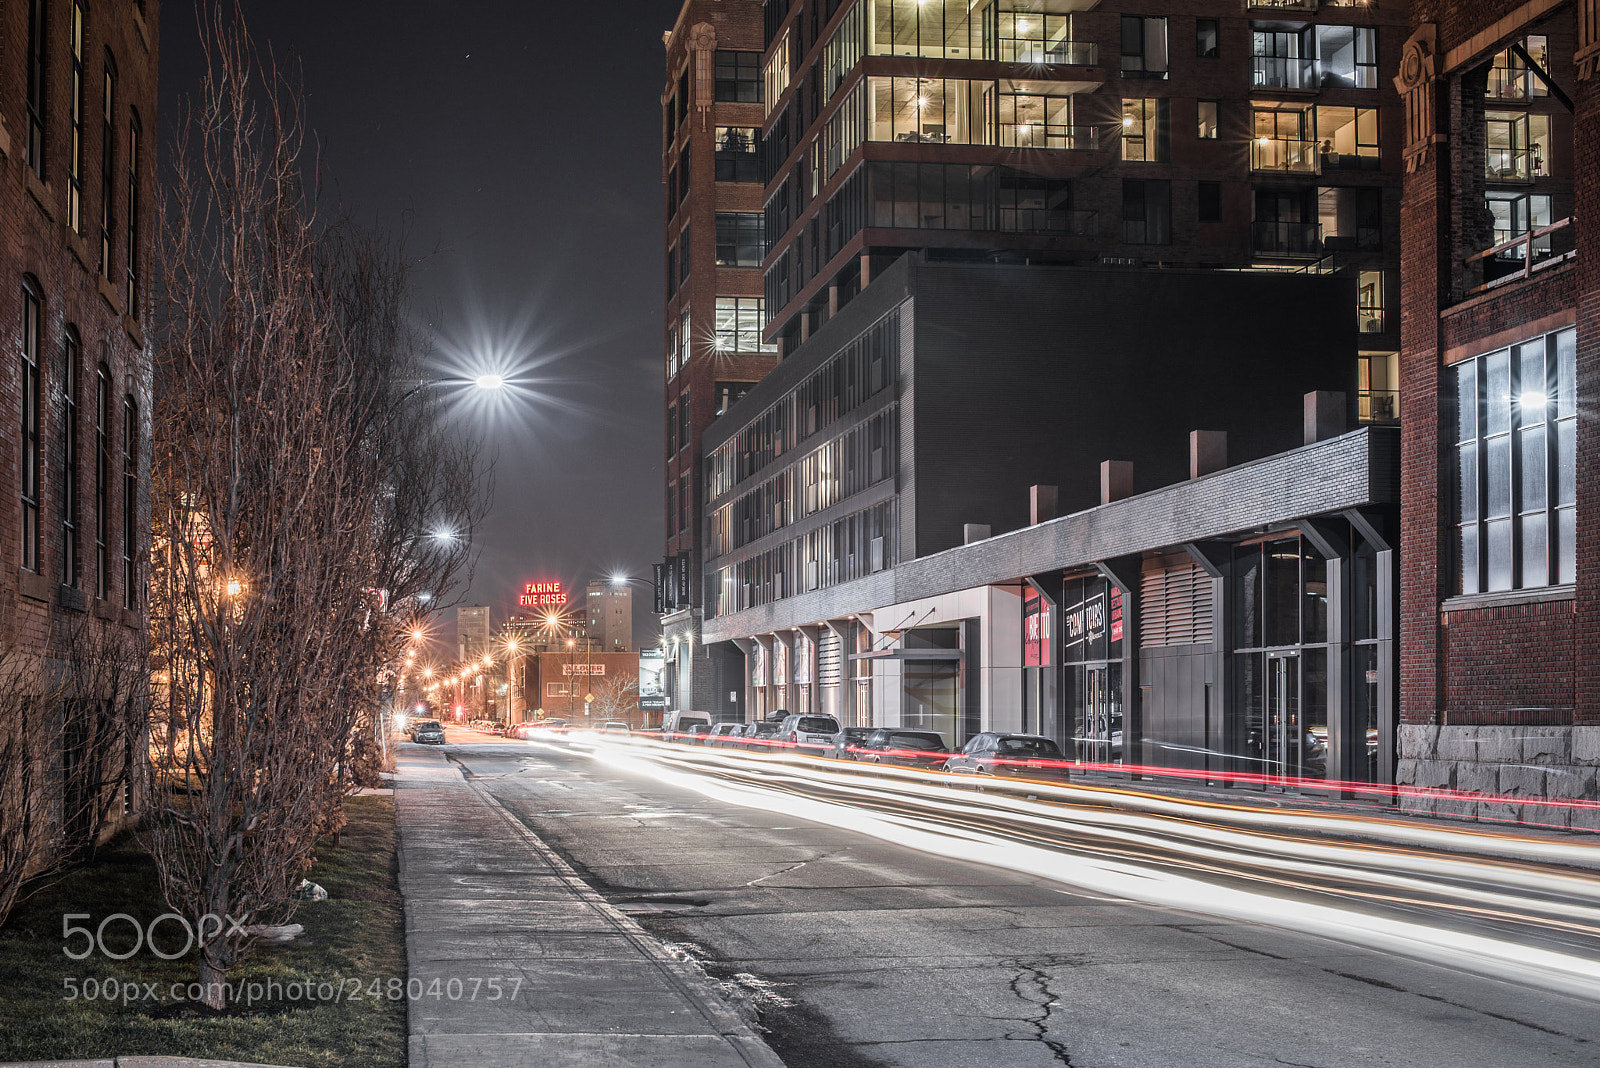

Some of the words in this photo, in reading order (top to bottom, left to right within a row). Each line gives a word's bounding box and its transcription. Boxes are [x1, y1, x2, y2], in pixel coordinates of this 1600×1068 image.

[526, 582, 560, 594] FARINE
[520, 594, 538, 605] FIVE
[540, 593, 567, 604] ROSES
